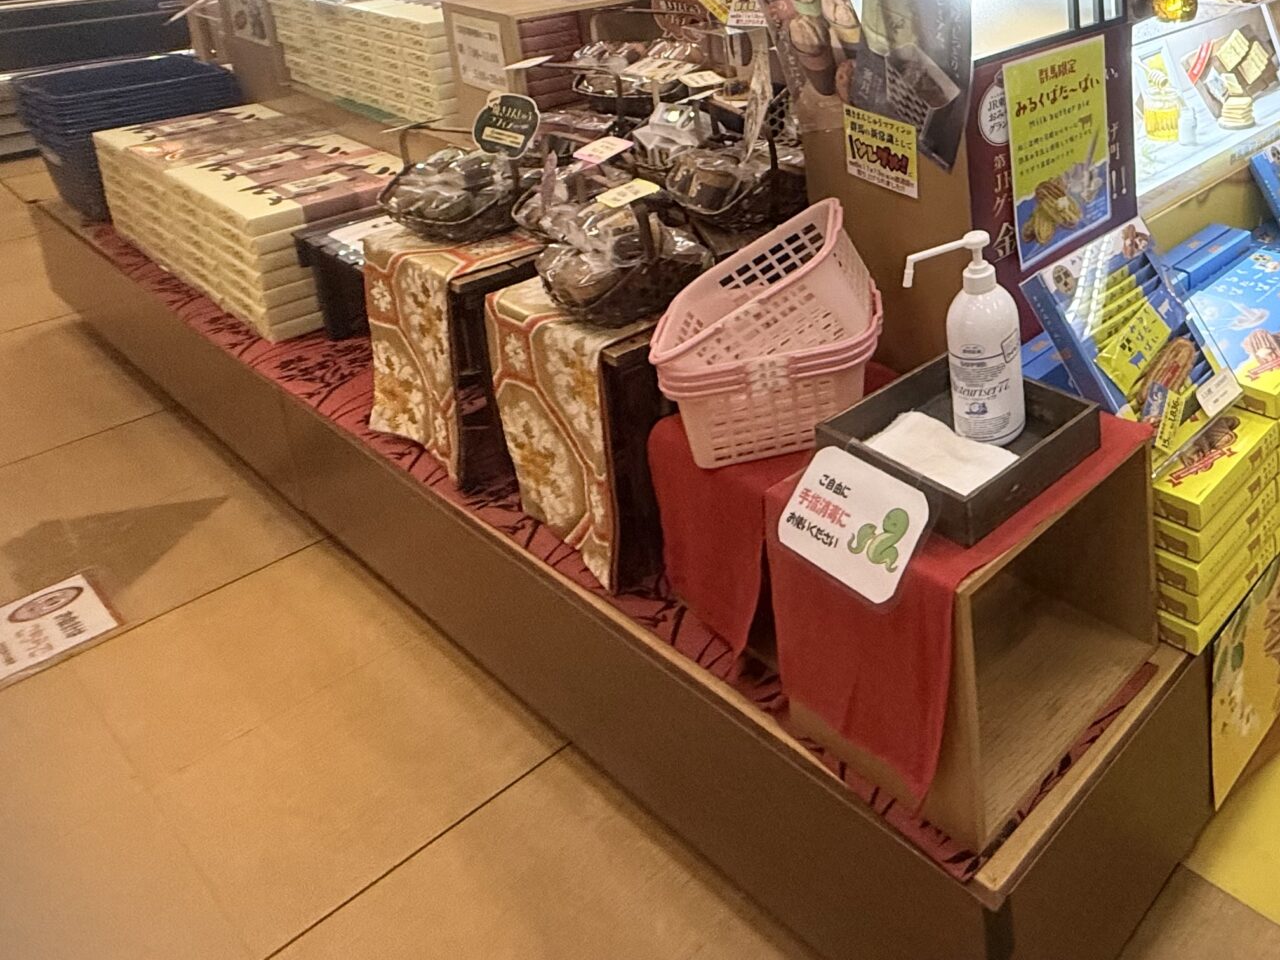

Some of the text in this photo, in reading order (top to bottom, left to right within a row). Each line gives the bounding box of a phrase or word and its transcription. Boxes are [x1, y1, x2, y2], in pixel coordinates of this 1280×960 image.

[1038, 59, 1077, 84] 群馬限定
[1029, 116, 1048, 128] Milk
[1049, 105, 1075, 121] butter
[818, 474, 852, 498] ご自由に
[798, 488, 851, 528] 手指消毒に
[786, 511, 839, 549] お使いください
